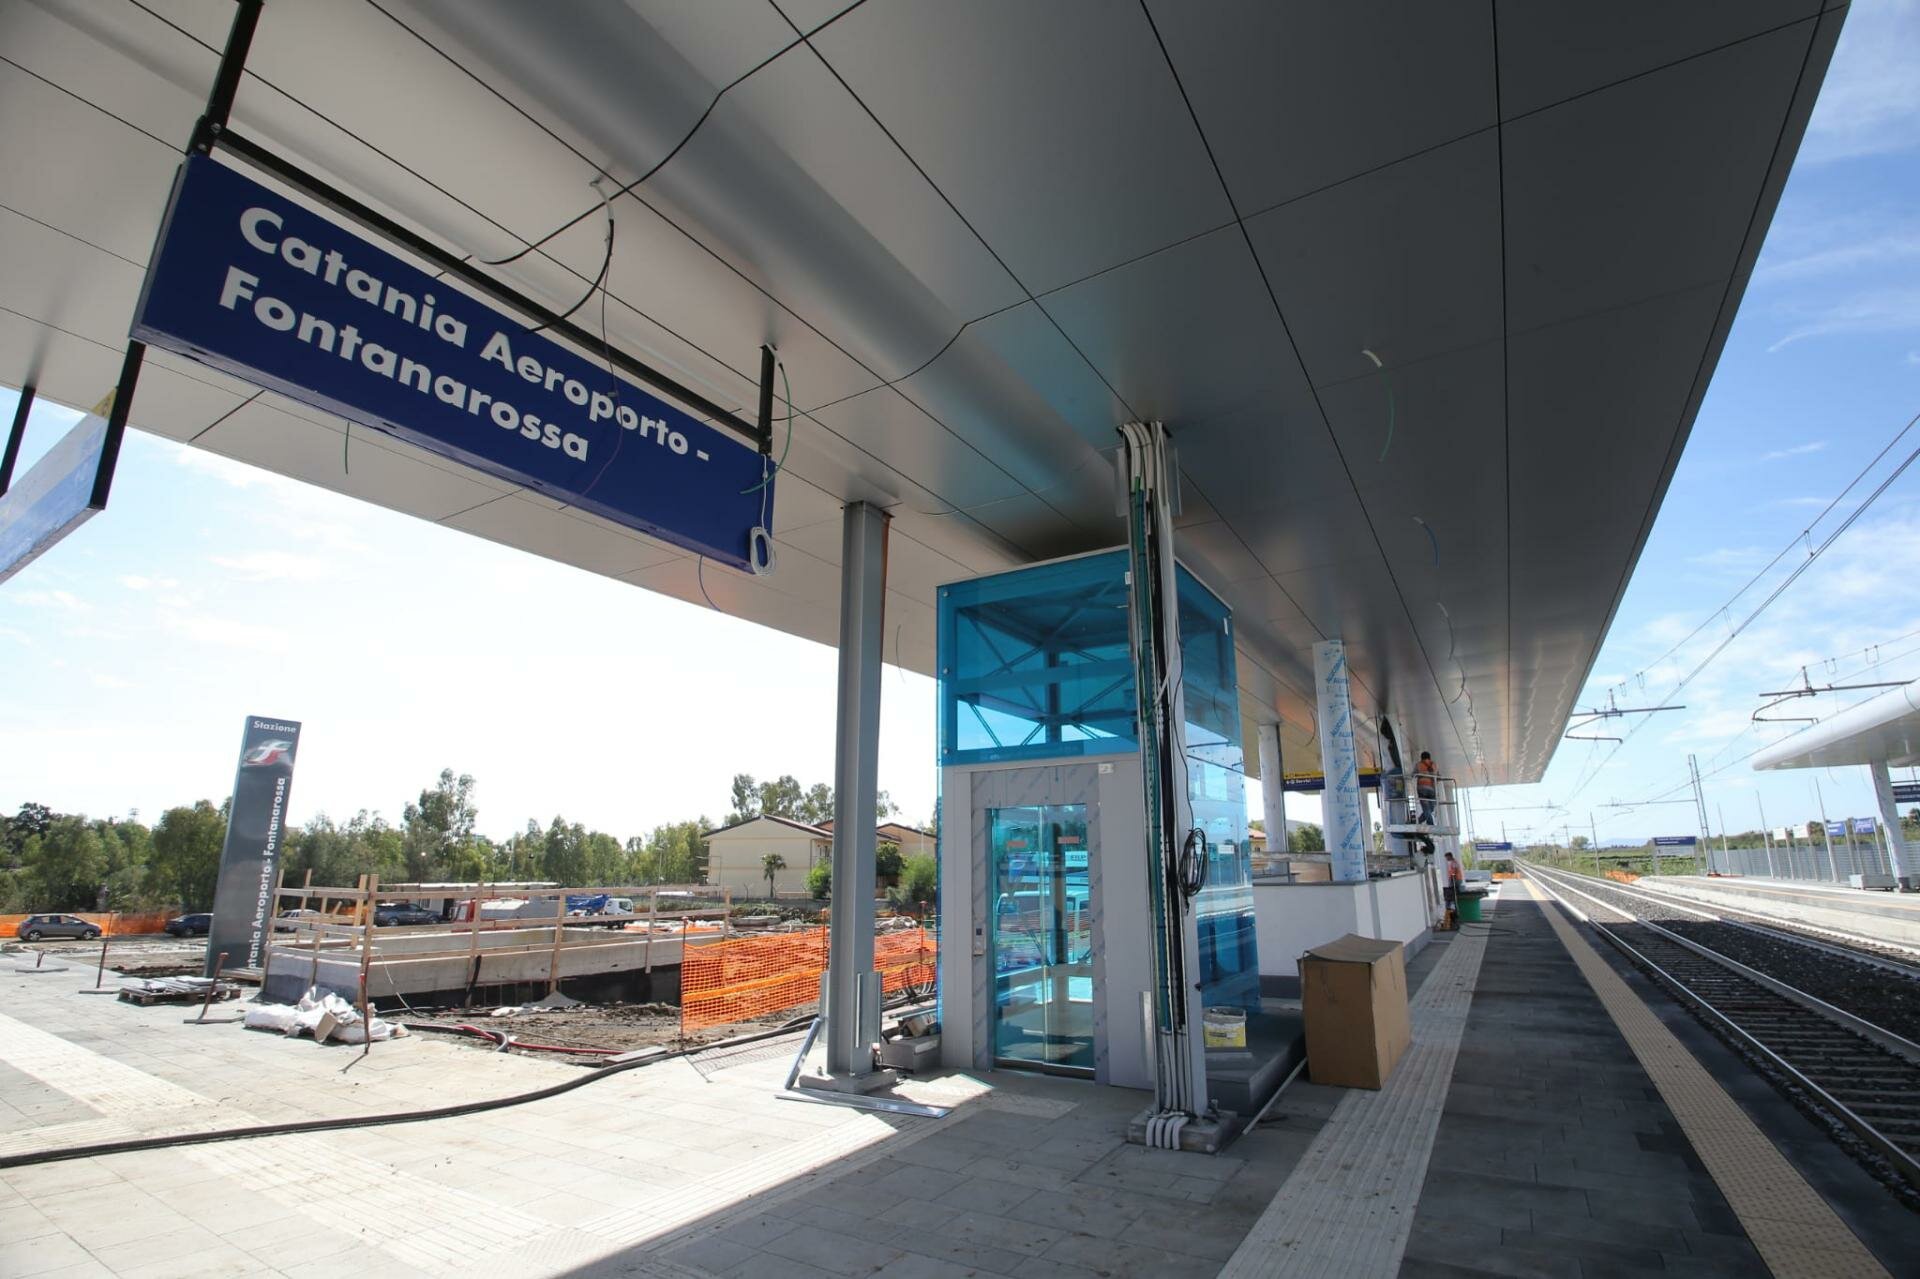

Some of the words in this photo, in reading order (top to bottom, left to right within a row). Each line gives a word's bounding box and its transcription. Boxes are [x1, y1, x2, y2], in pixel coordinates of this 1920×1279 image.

[220, 266, 590, 463] Fontanarossa
[240, 207, 468, 348] Catania
[480, 332, 688, 455] Aeroporto
[695, 448, 712, 462] -
[253, 720, 297, 734] Stazione
[264, 777, 286, 857] Fontanarossa
[252, 864, 273, 929] Aeroporto
[248, 931, 262, 969] atania
